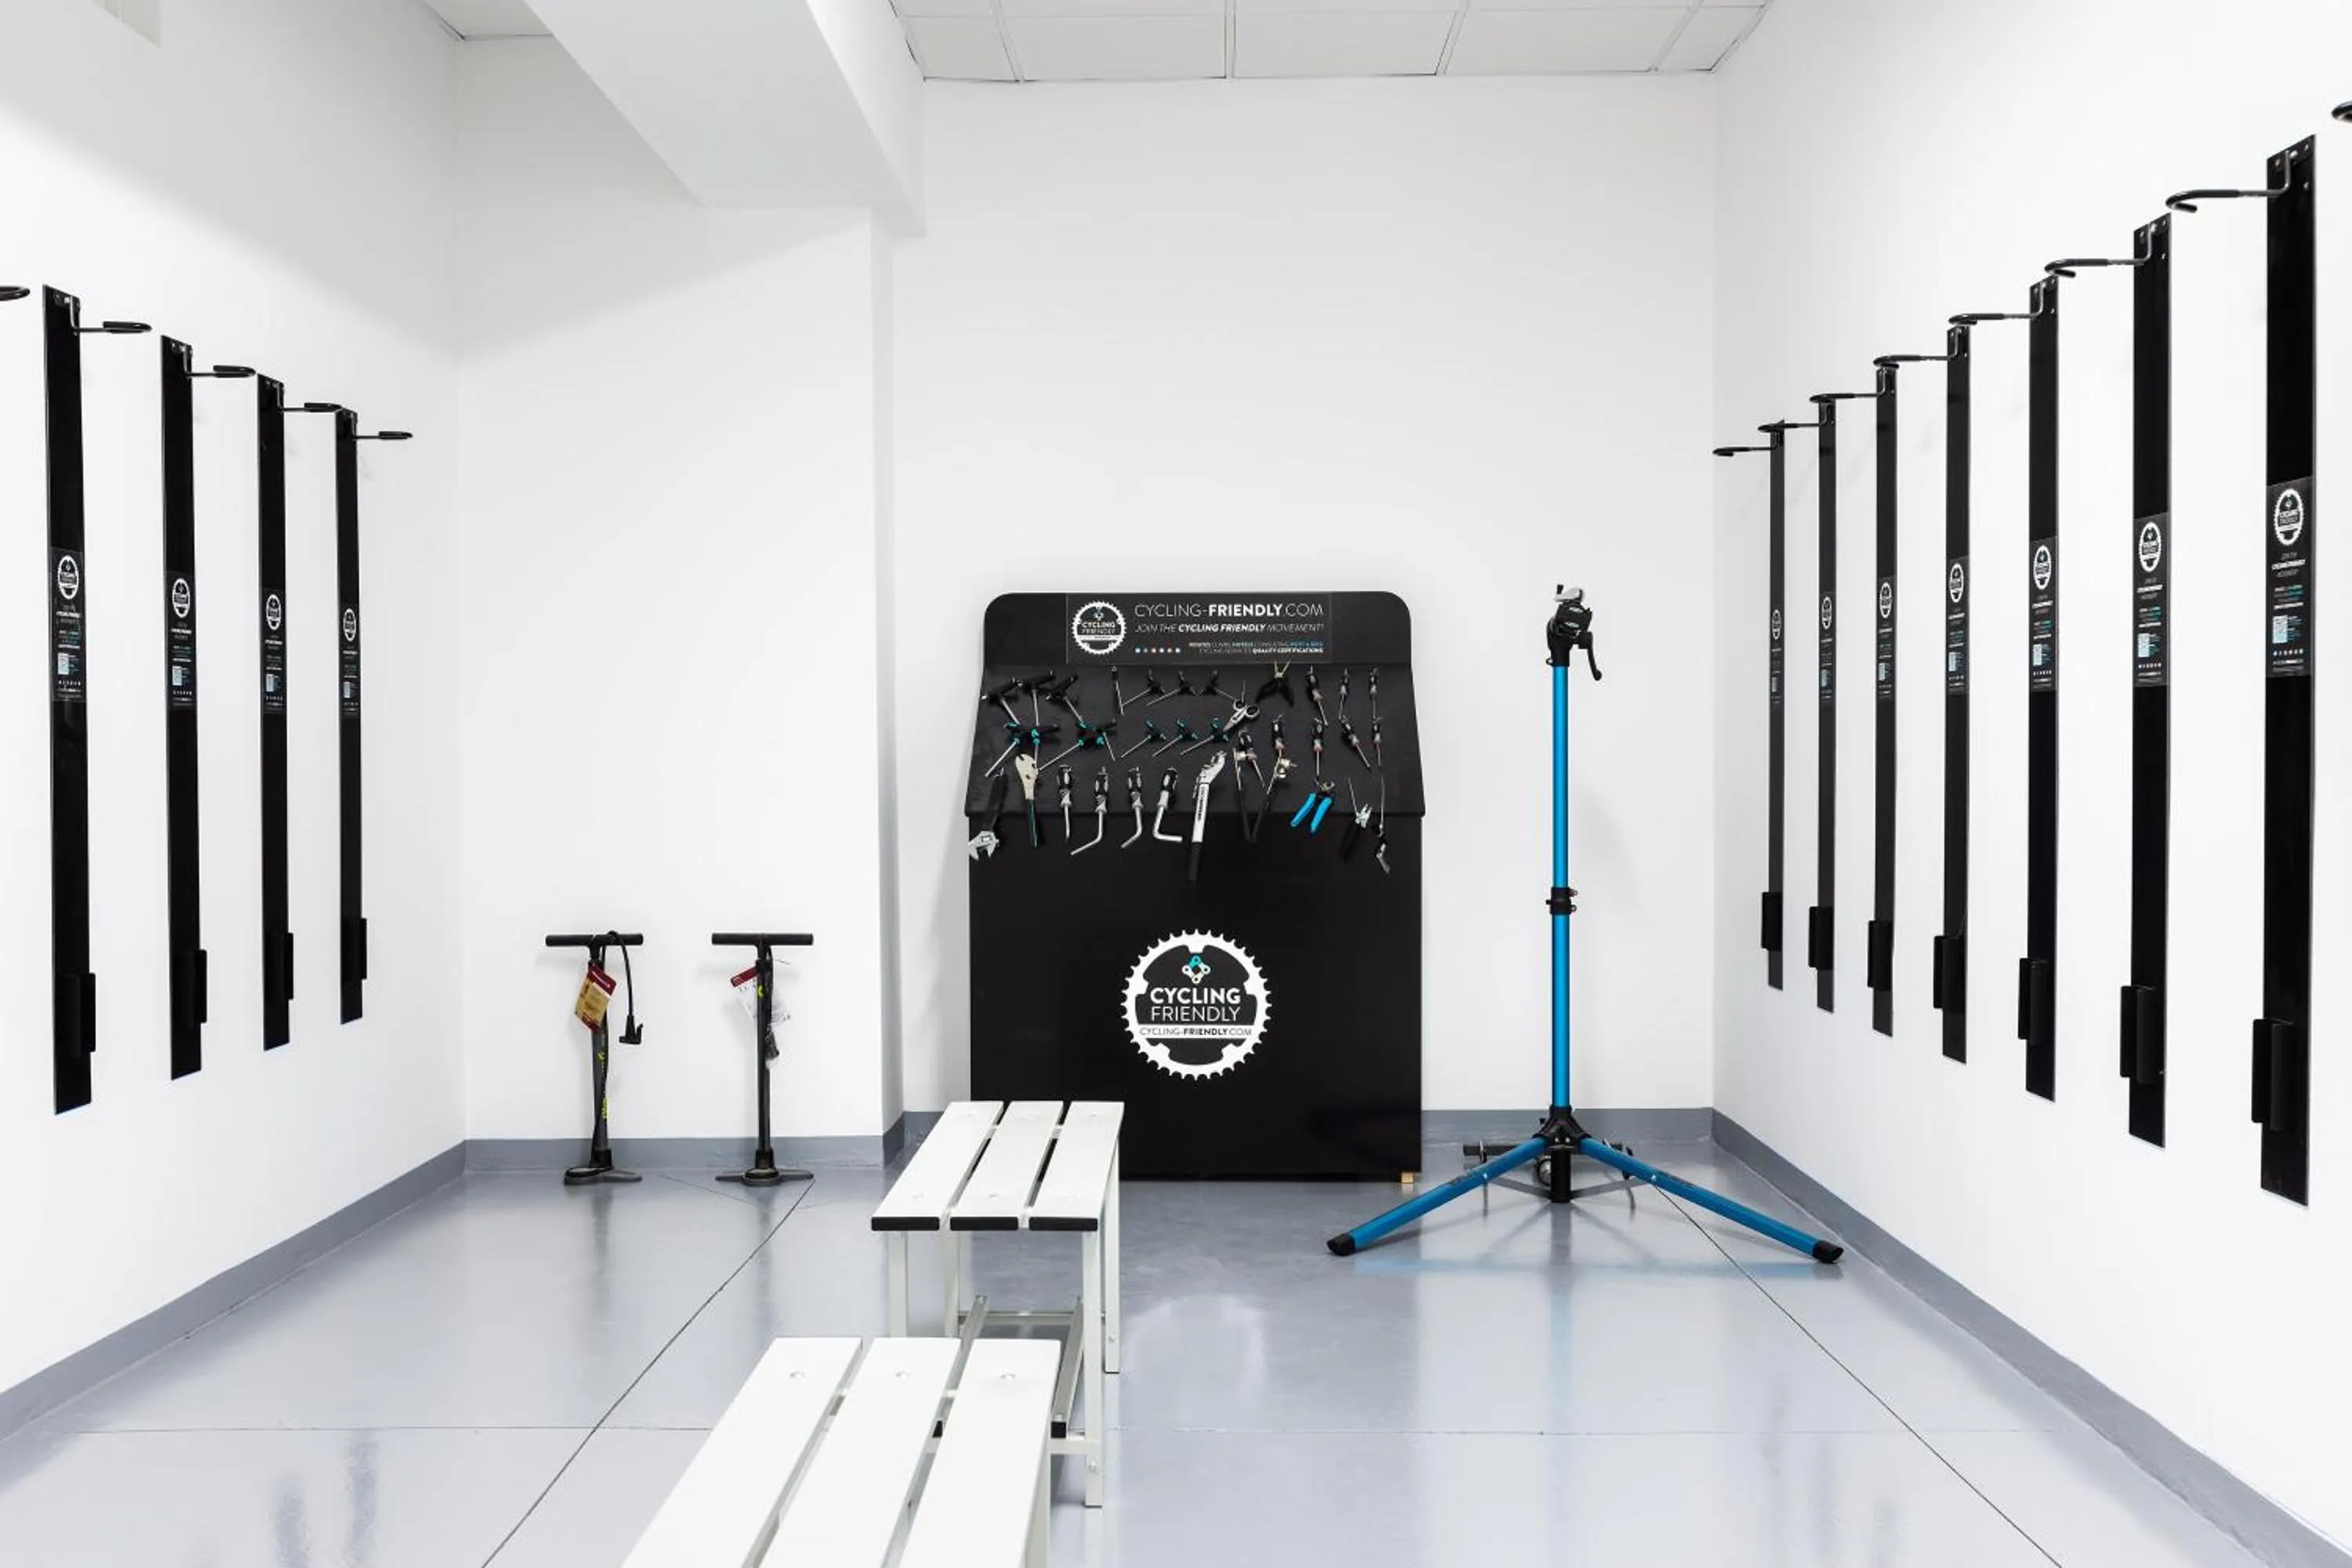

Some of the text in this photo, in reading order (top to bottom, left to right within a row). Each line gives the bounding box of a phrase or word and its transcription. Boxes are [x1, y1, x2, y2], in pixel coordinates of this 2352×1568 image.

[1134, 603, 1323, 617] CYCLING-FRIENDLY.COM
[1178, 623, 1218, 633] CYCLING
[1220, 623, 1266, 633] FRIENDLY
[1150, 987, 1241, 1004] CYCLING
[1152, 1006, 1241, 1022] FRIENDLY
[1139, 1027, 1252, 1036] CYCLING-FRIENDLY.COM
